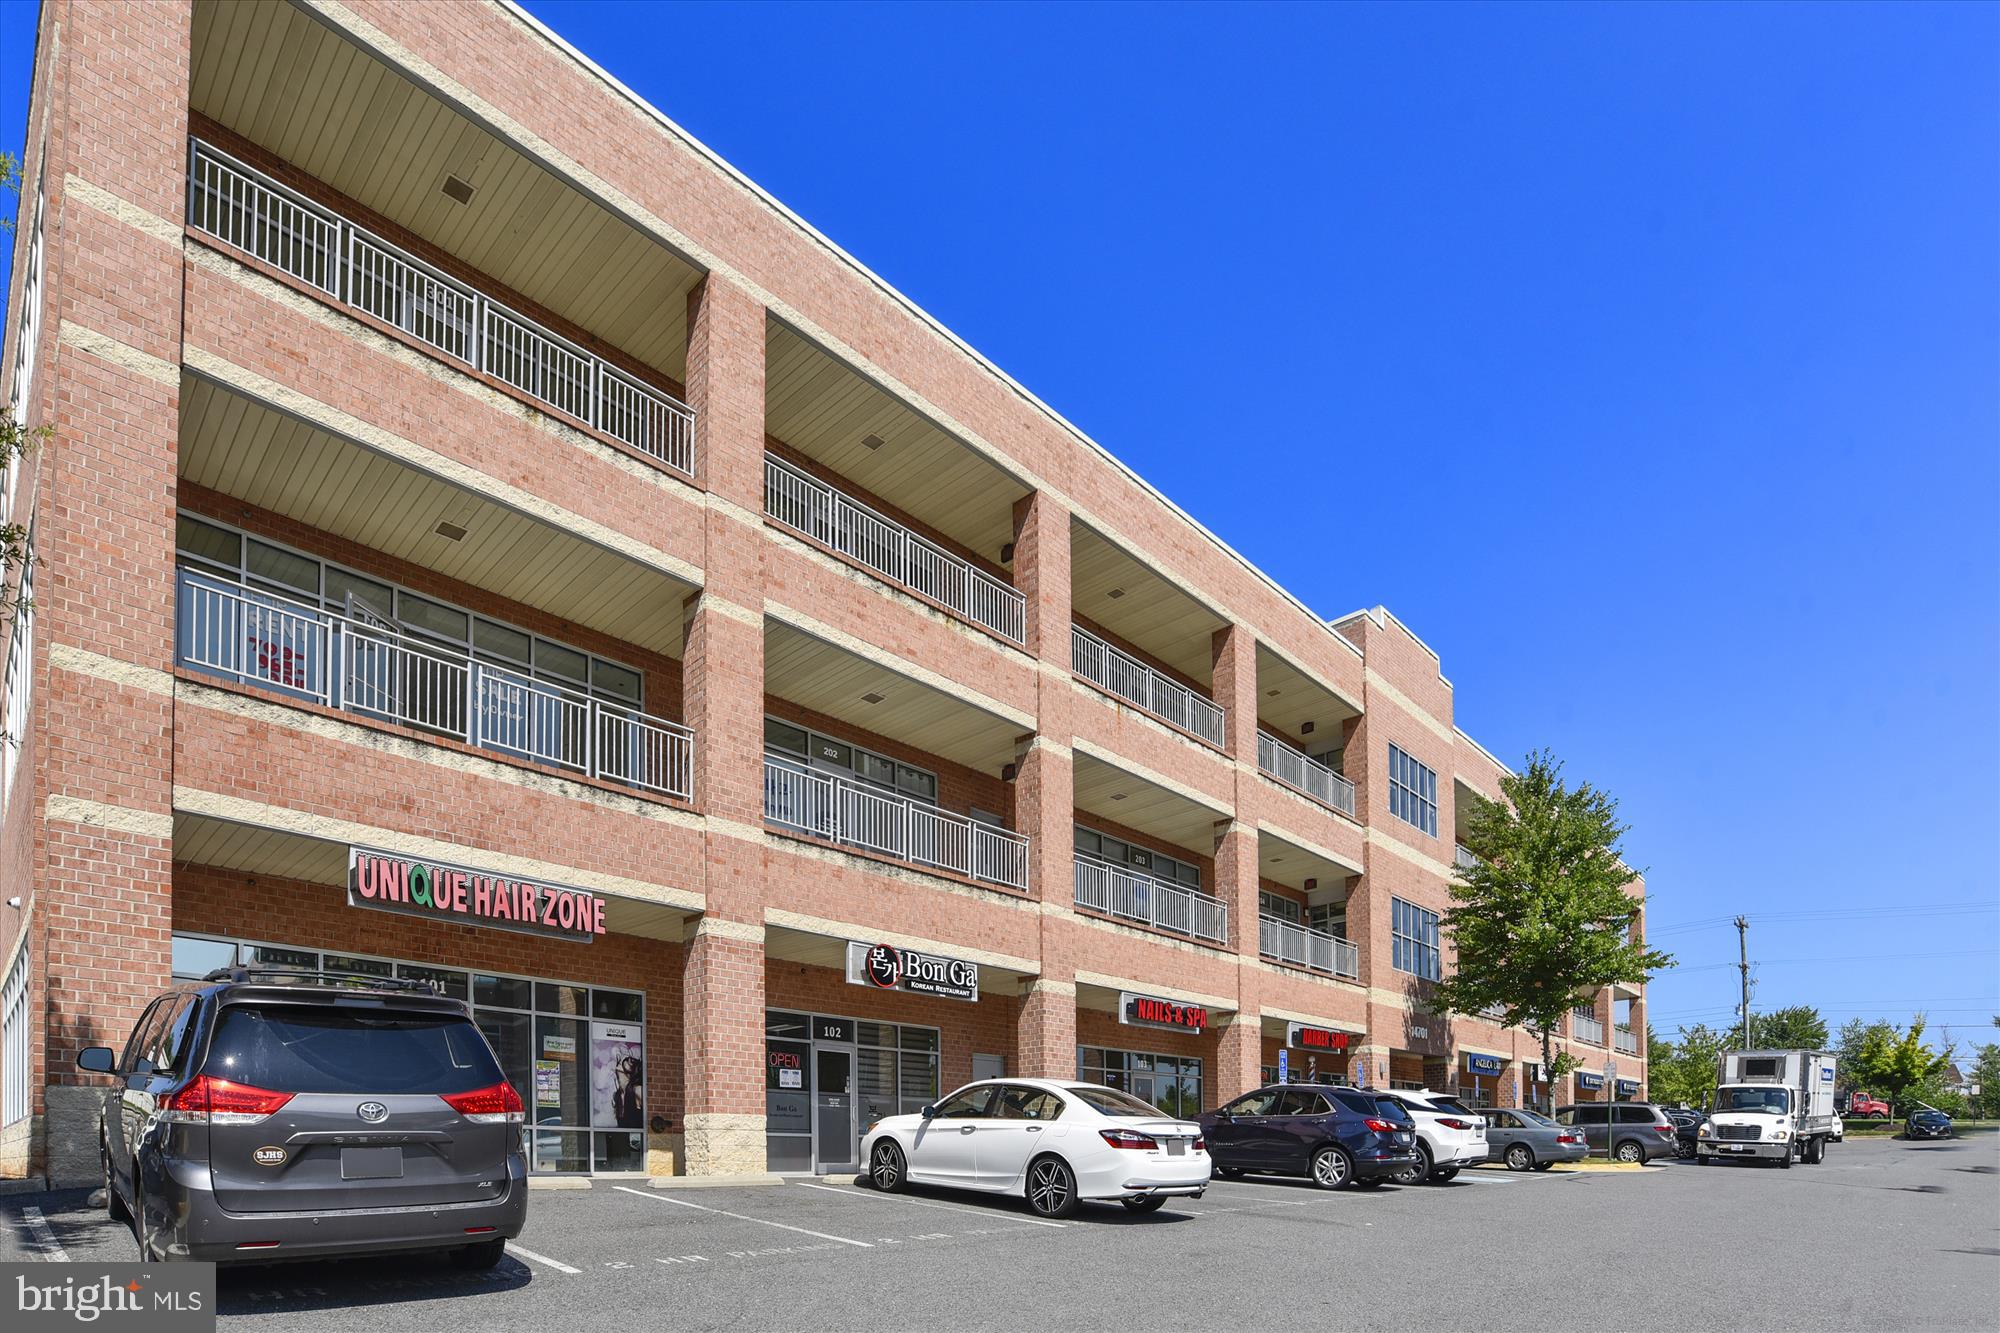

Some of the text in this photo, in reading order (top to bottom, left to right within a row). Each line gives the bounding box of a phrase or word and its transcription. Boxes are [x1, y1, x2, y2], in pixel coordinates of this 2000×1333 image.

[427, 285, 454, 310] 301
[248, 610, 310, 642] RENT
[823, 747, 838, 759] 202
[1135, 854, 1146, 865] 203
[357, 854, 606, 935] UNIQUE HAIR ZONE
[905, 951, 977, 987] Bon Ga
[911, 981, 971, 997] KOREAN RESTAURANT
[1137, 998, 1207, 1028] NAILS & SPA
[823, 1026, 841, 1038] 102
[1303, 1028, 1349, 1049] BARBER SHOP
[769, 1052, 799, 1068] OPEN
[256, 1151, 284, 1159] SJHS
[655, 1255, 710, 1264] HR
